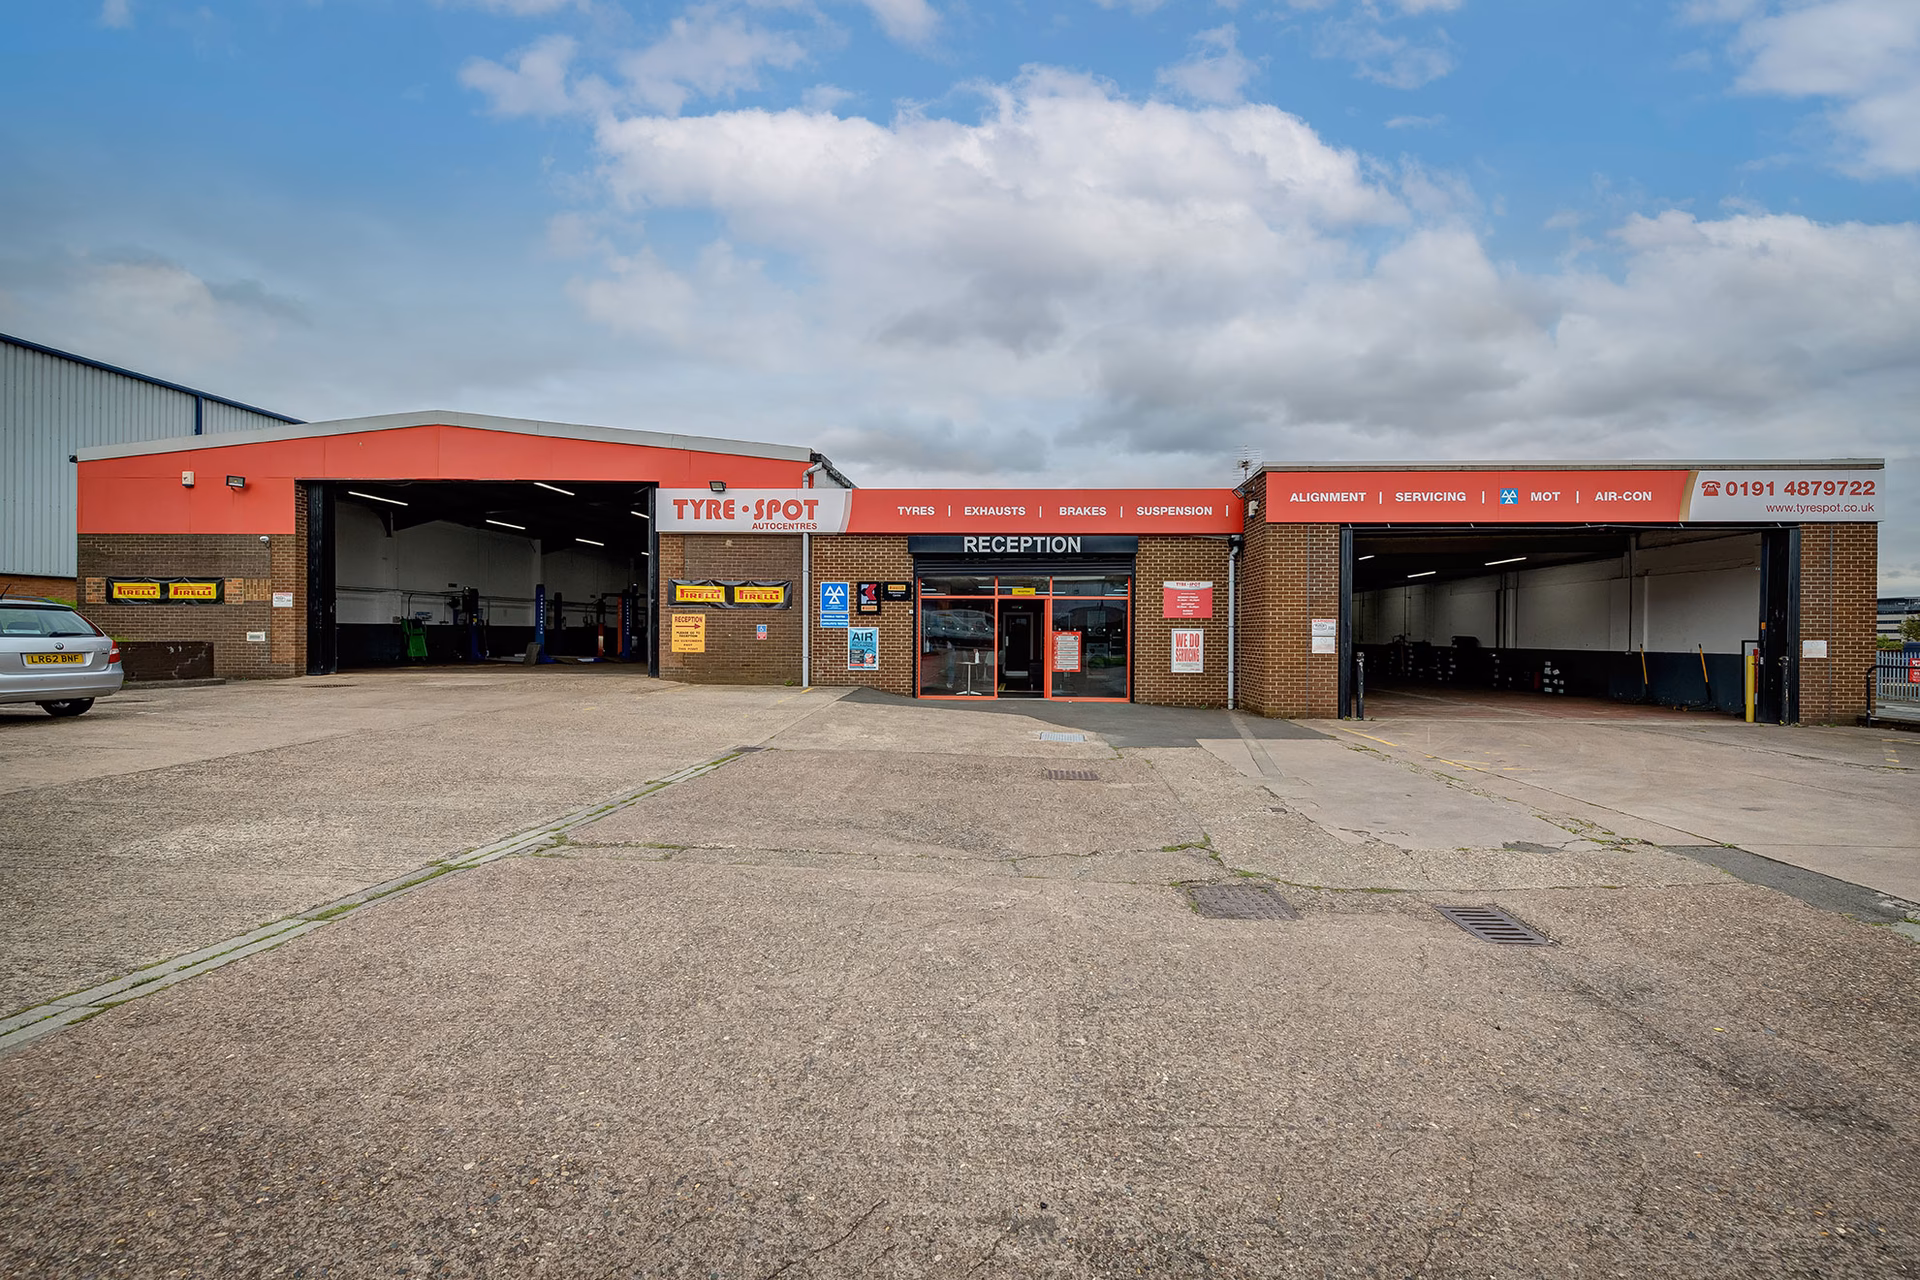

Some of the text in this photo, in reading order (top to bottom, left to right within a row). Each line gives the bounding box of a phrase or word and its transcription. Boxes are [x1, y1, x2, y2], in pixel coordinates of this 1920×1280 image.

[1725, 480, 1876, 497] 0191 4879722
[1289, 491, 1367, 503] ALIGNMENT
[1394, 491, 1467, 503] SERVICING
[1530, 491, 1561, 502] MOT
[1594, 491, 1653, 502] AIR-CON
[673, 498, 819, 521] TYRE SPOT
[897, 505, 936, 516] TYRES
[963, 505, 1027, 517] EXHAUSTS
[1058, 505, 1108, 516] BRAKES
[1135, 505, 1214, 517] SUSPENSION
[1765, 502, 1875, 515] www.tyrespot.co.uk
[751, 522, 818, 531] AUTOCENTRES
[963, 535, 1083, 553] RECEPTION
[117, 585, 213, 597] PIRELLI PIRELLI
[680, 588, 780, 601] PIRELLI PIRELLI
[852, 632, 873, 642] AIR
[1175, 633, 1200, 648] WE DO
[31, 654, 79, 664] LR62 BNF
